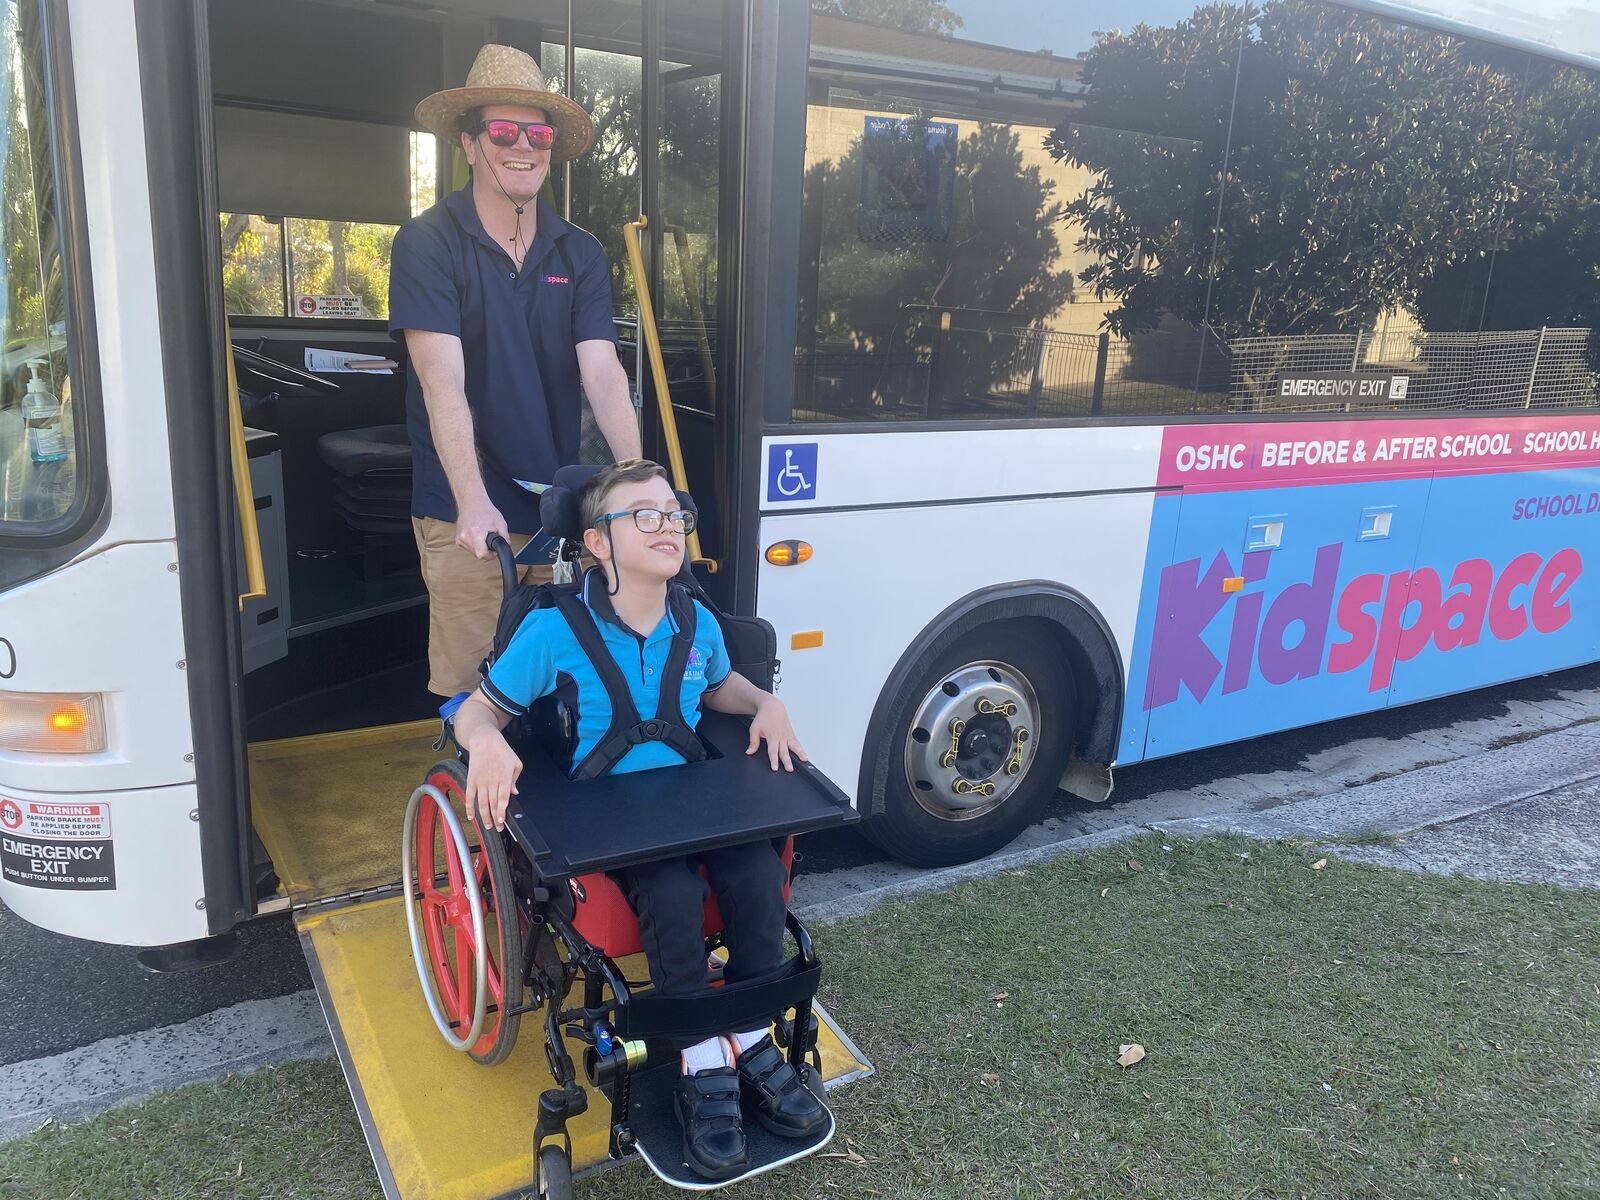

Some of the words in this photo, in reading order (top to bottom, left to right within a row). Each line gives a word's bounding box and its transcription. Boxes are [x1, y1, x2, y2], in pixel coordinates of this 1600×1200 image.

[1281, 379, 1357, 396] EMERGENCY
[1359, 380, 1387, 396] EXIT
[1176, 443, 1246, 472] OSHC
[1261, 440, 1350, 467] BEFORE
[1352, 439, 1367, 463] &
[1372, 436, 1437, 461] AFTER
[1439, 434, 1512, 458] SCHOOL
[1523, 431, 1587, 454] SCHOOL
[1512, 494, 1583, 520] SCHOOL
[1585, 492, 1600, 513] D
[1, 808, 20, 821] STOP
[36, 805, 91, 815] WARNING
[27, 814, 55, 822] PARKING
[32, 828, 61, 836] CLOSING
[3, 838, 103, 859] EMERGENCY
[5, 867, 19, 876] PUSH
[20, 871, 48, 882] BUTTON
[30, 859, 70, 875] EXIT
